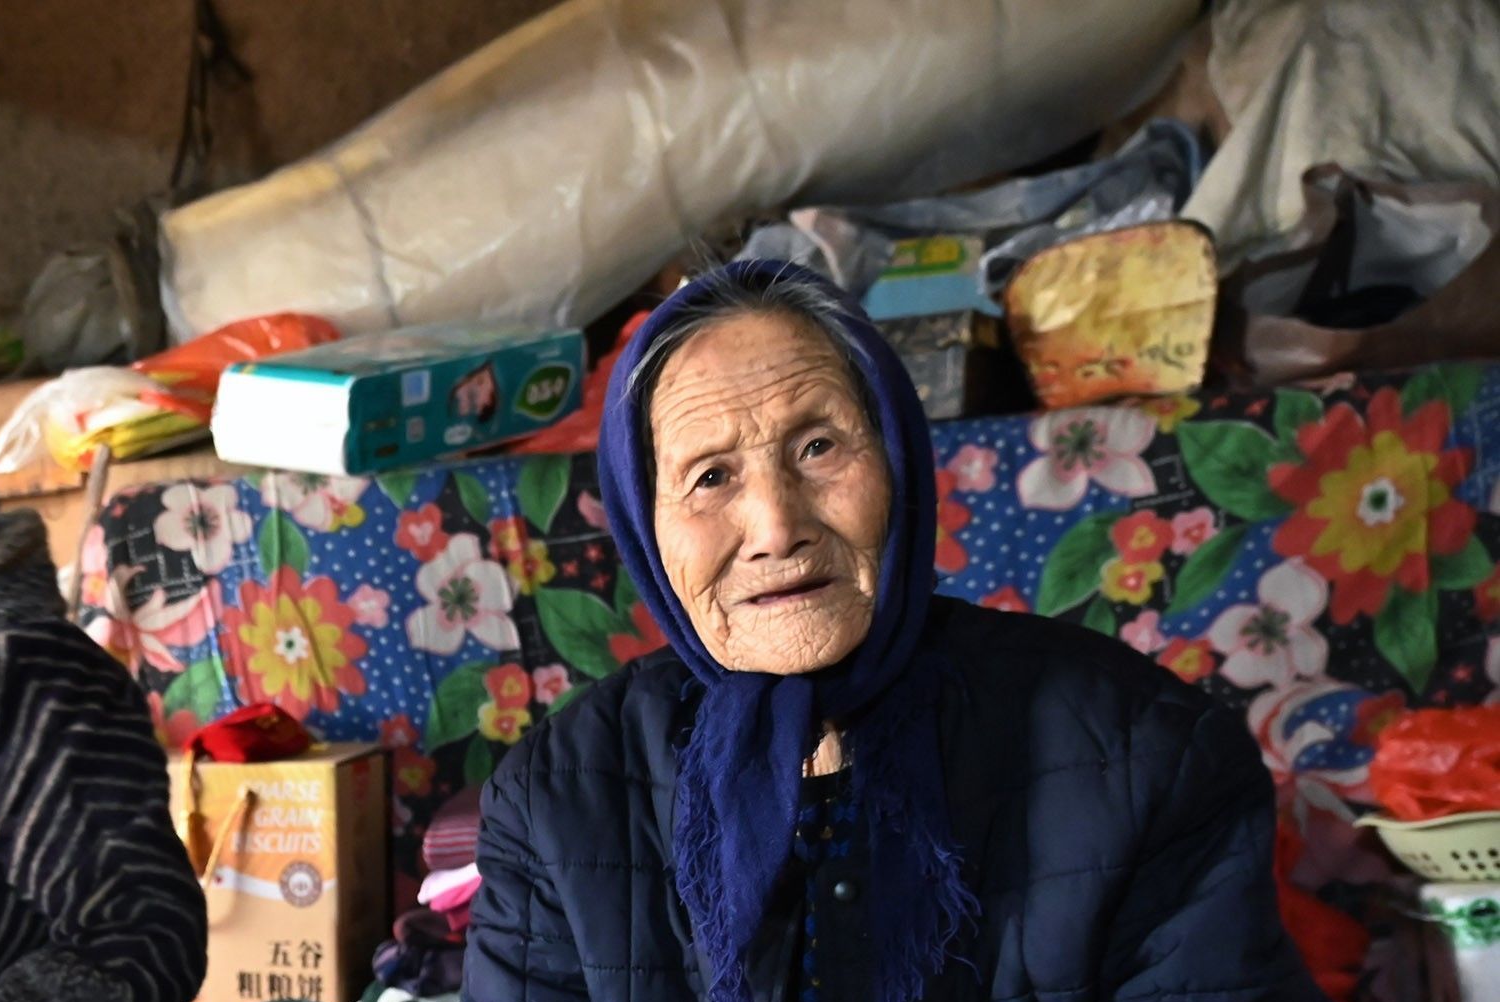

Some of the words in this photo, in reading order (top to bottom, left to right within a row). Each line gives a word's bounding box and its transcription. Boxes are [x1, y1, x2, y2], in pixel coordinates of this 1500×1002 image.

[254, 806, 323, 828] GRAIN
[266, 940, 322, 969] 五谷
[237, 971, 322, 1002] 粗粮饼
